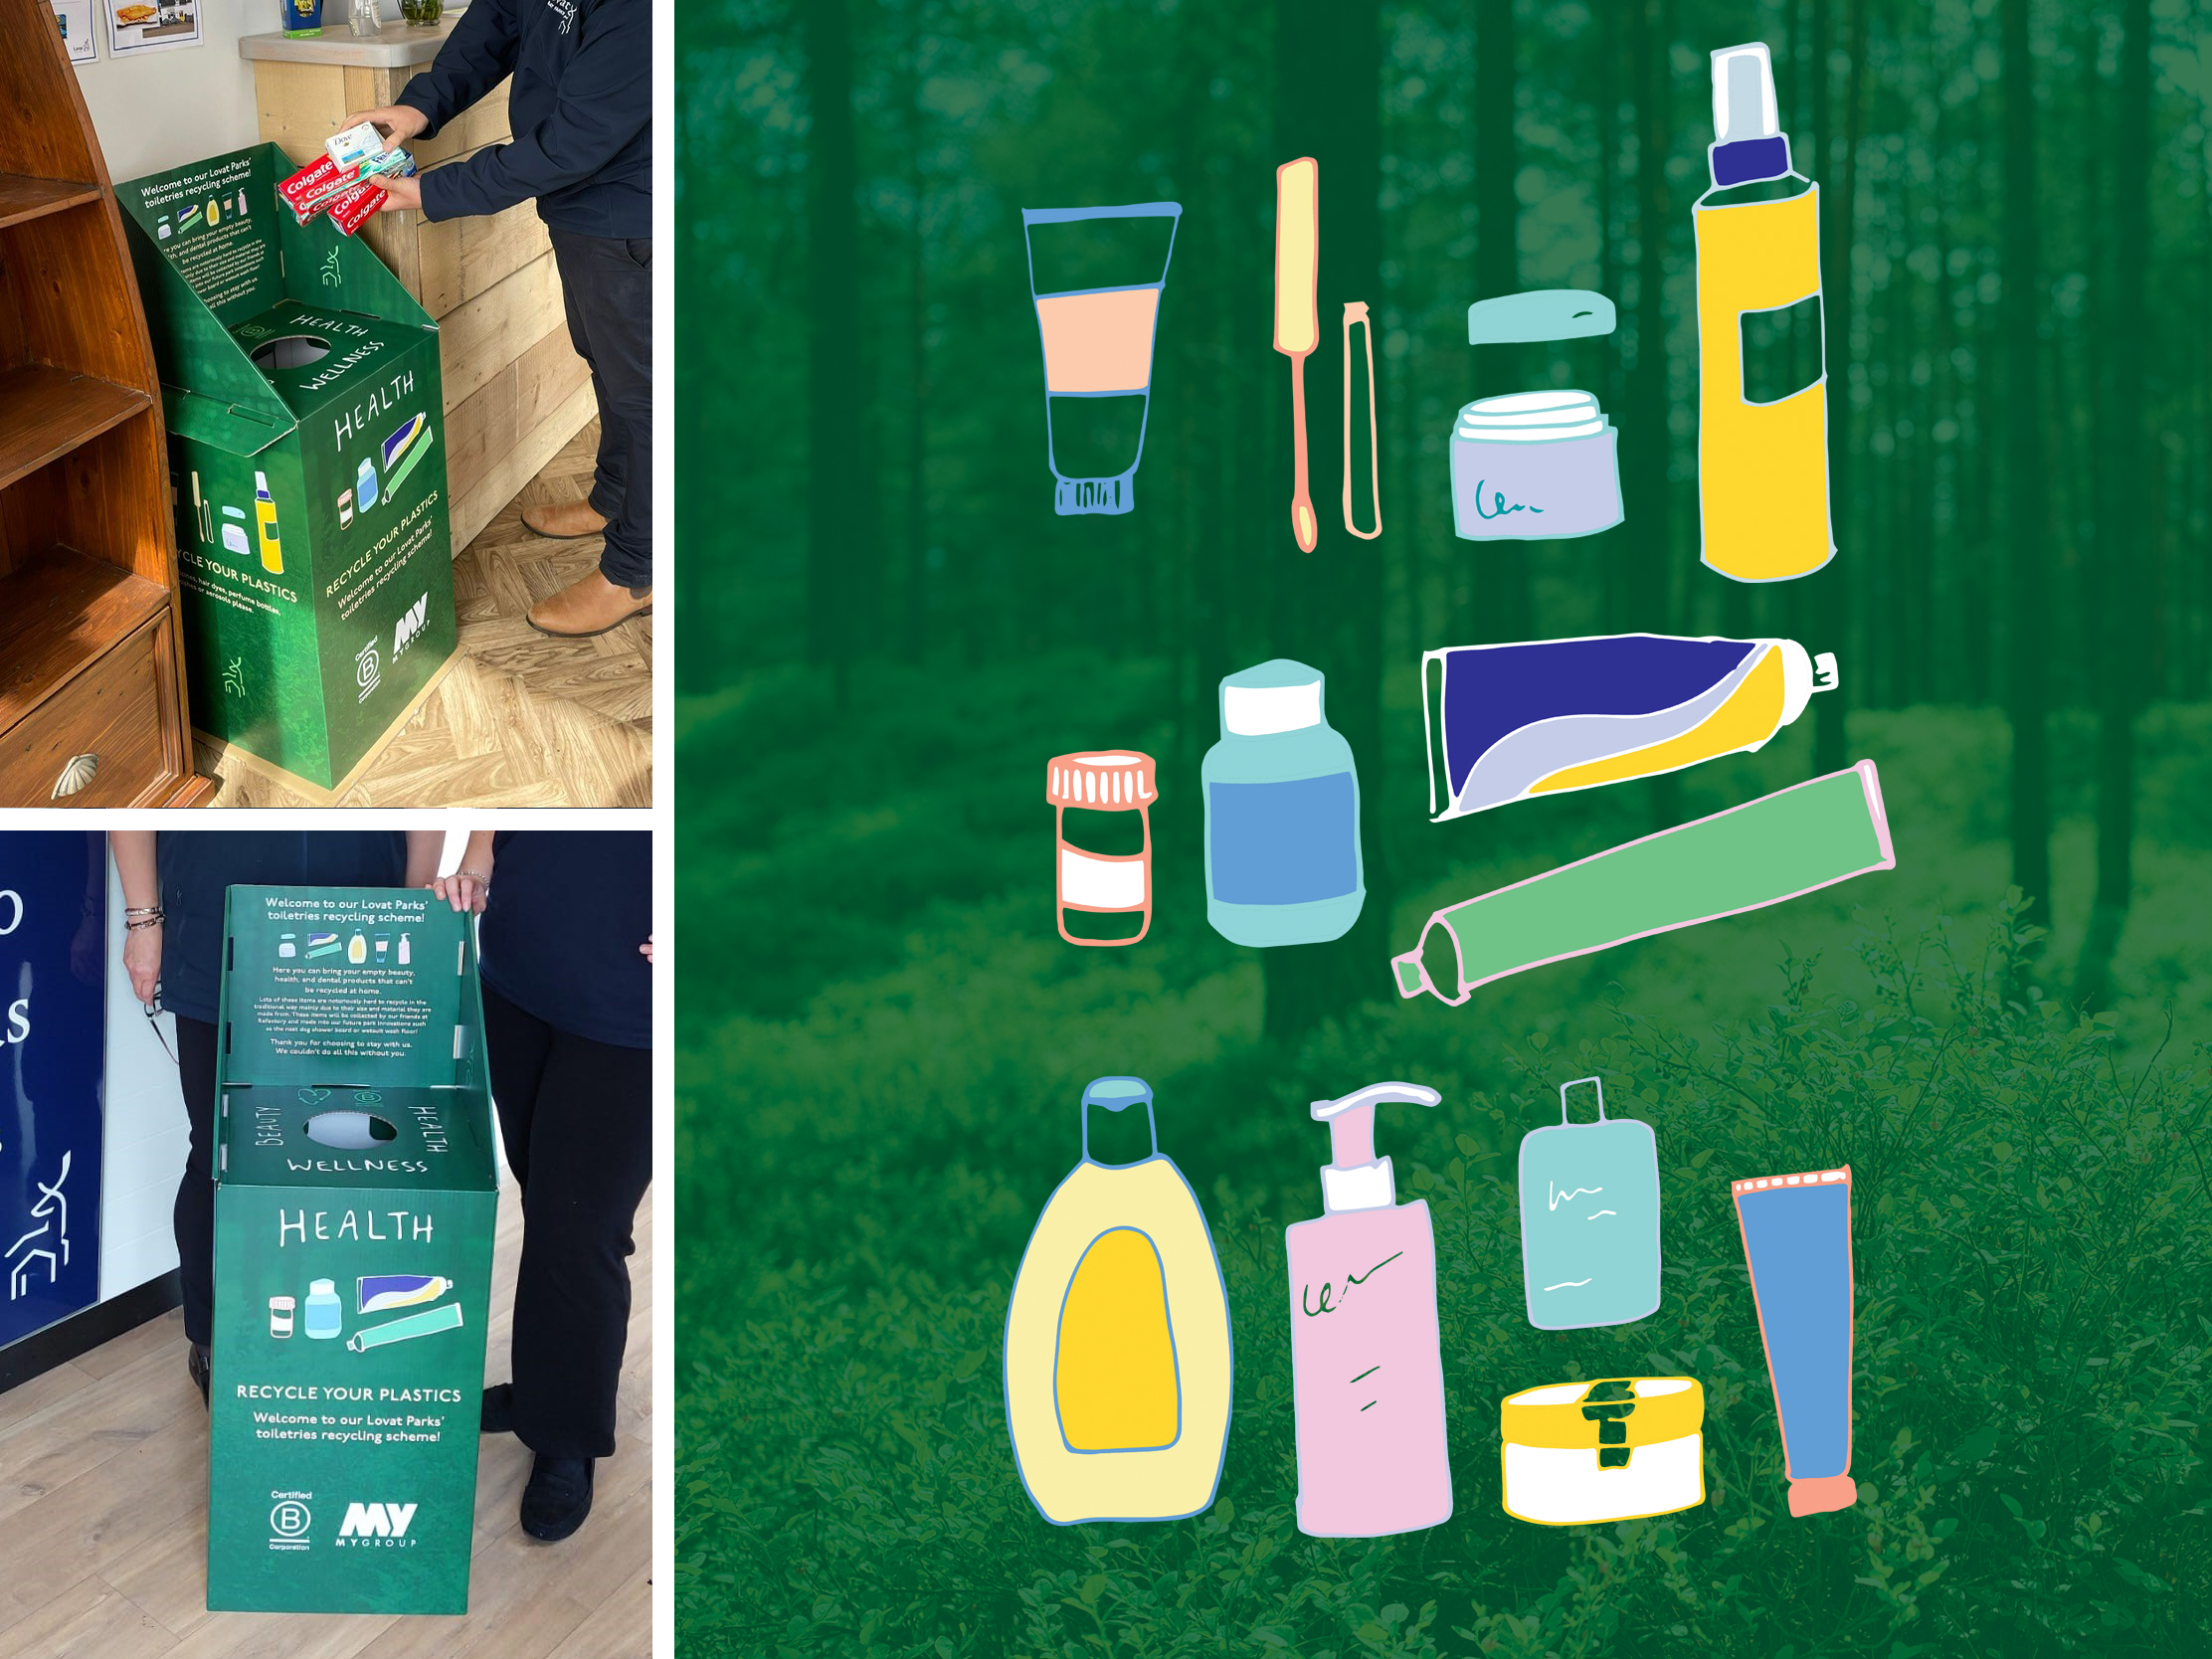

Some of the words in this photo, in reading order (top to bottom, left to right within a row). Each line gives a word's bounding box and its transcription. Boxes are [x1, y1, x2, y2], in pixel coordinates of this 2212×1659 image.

[334, 134, 352, 146] Dove
[141, 180, 182, 197] Welcome
[194, 172, 208, 181] our
[209, 164, 230, 177] Lovat
[144, 191, 184, 209] toiletries
[185, 181, 221, 196] recycling
[221, 169, 252, 185] scheme!
[286, 160, 333, 195] Colgate
[305, 169, 355, 199] Colgate
[346, 189, 387, 229] Colgate
[170, 244, 181, 253] you
[206, 230, 218, 239] your
[218, 224, 234, 233] empty
[179, 248, 189, 257] and
[190, 241, 206, 253] dental
[207, 234, 229, 247] products
[190, 249, 212, 262] recycled
[289, 313, 368, 337] HEALTH
[298, 340, 386, 391] WELLNESS
[334, 370, 415, 453] HEALTH
[326, 549, 372, 598] RECYCLE
[373, 526, 400, 555] YOUR
[400, 489, 439, 531] PLASTICS
[205, 558, 239, 582] YOUR
[241, 573, 297, 604] PLASTICS
[337, 574, 374, 610] Welcome
[375, 565, 383, 576] to
[384, 551, 397, 567] our
[397, 534, 415, 555] Lovat
[340, 586, 375, 621] toiletries
[376, 556, 407, 589] recycling
[407, 529, 433, 559] scheme!
[198, 578, 210, 587] hair
[211, 583, 228, 595] dyes,
[228, 590, 256, 606] perfume
[206, 588, 231, 604] aerosols
[393, 591, 429, 655] MY
[355, 635, 378, 661] Certified
[266, 897, 320, 908] Welcome
[323, 899, 335, 909] to
[338, 900, 359, 909] our
[361, 899, 392, 910] Lovat
[268, 911, 320, 921] toiletries
[323, 912, 375, 925] recycling
[378, 913, 425, 923] scheme!
[255, 1106, 284, 1147] BEAUTY
[407, 1106, 449, 1154] HEALTH
[286, 1158, 430, 1173] WELLNESS
[279, 1207, 435, 1248] HEALTH
[237, 1384, 318, 1399] RECYCLE
[322, 1386, 374, 1400] YOUR
[379, 1387, 461, 1402] PLASTICS
[253, 1411, 318, 1424] Welcome
[321, 1414, 336, 1425] to
[340, 1416, 363, 1425] our
[367, 1415, 403, 1426] Lovat
[256, 1428, 317, 1440] toiletries
[321, 1430, 382, 1445] recycling
[386, 1430, 441, 1442] scheme!
[271, 1490, 312, 1500] Certified
[338, 1502, 419, 1538] MY
[335, 1539, 417, 1548] MYGROUP
